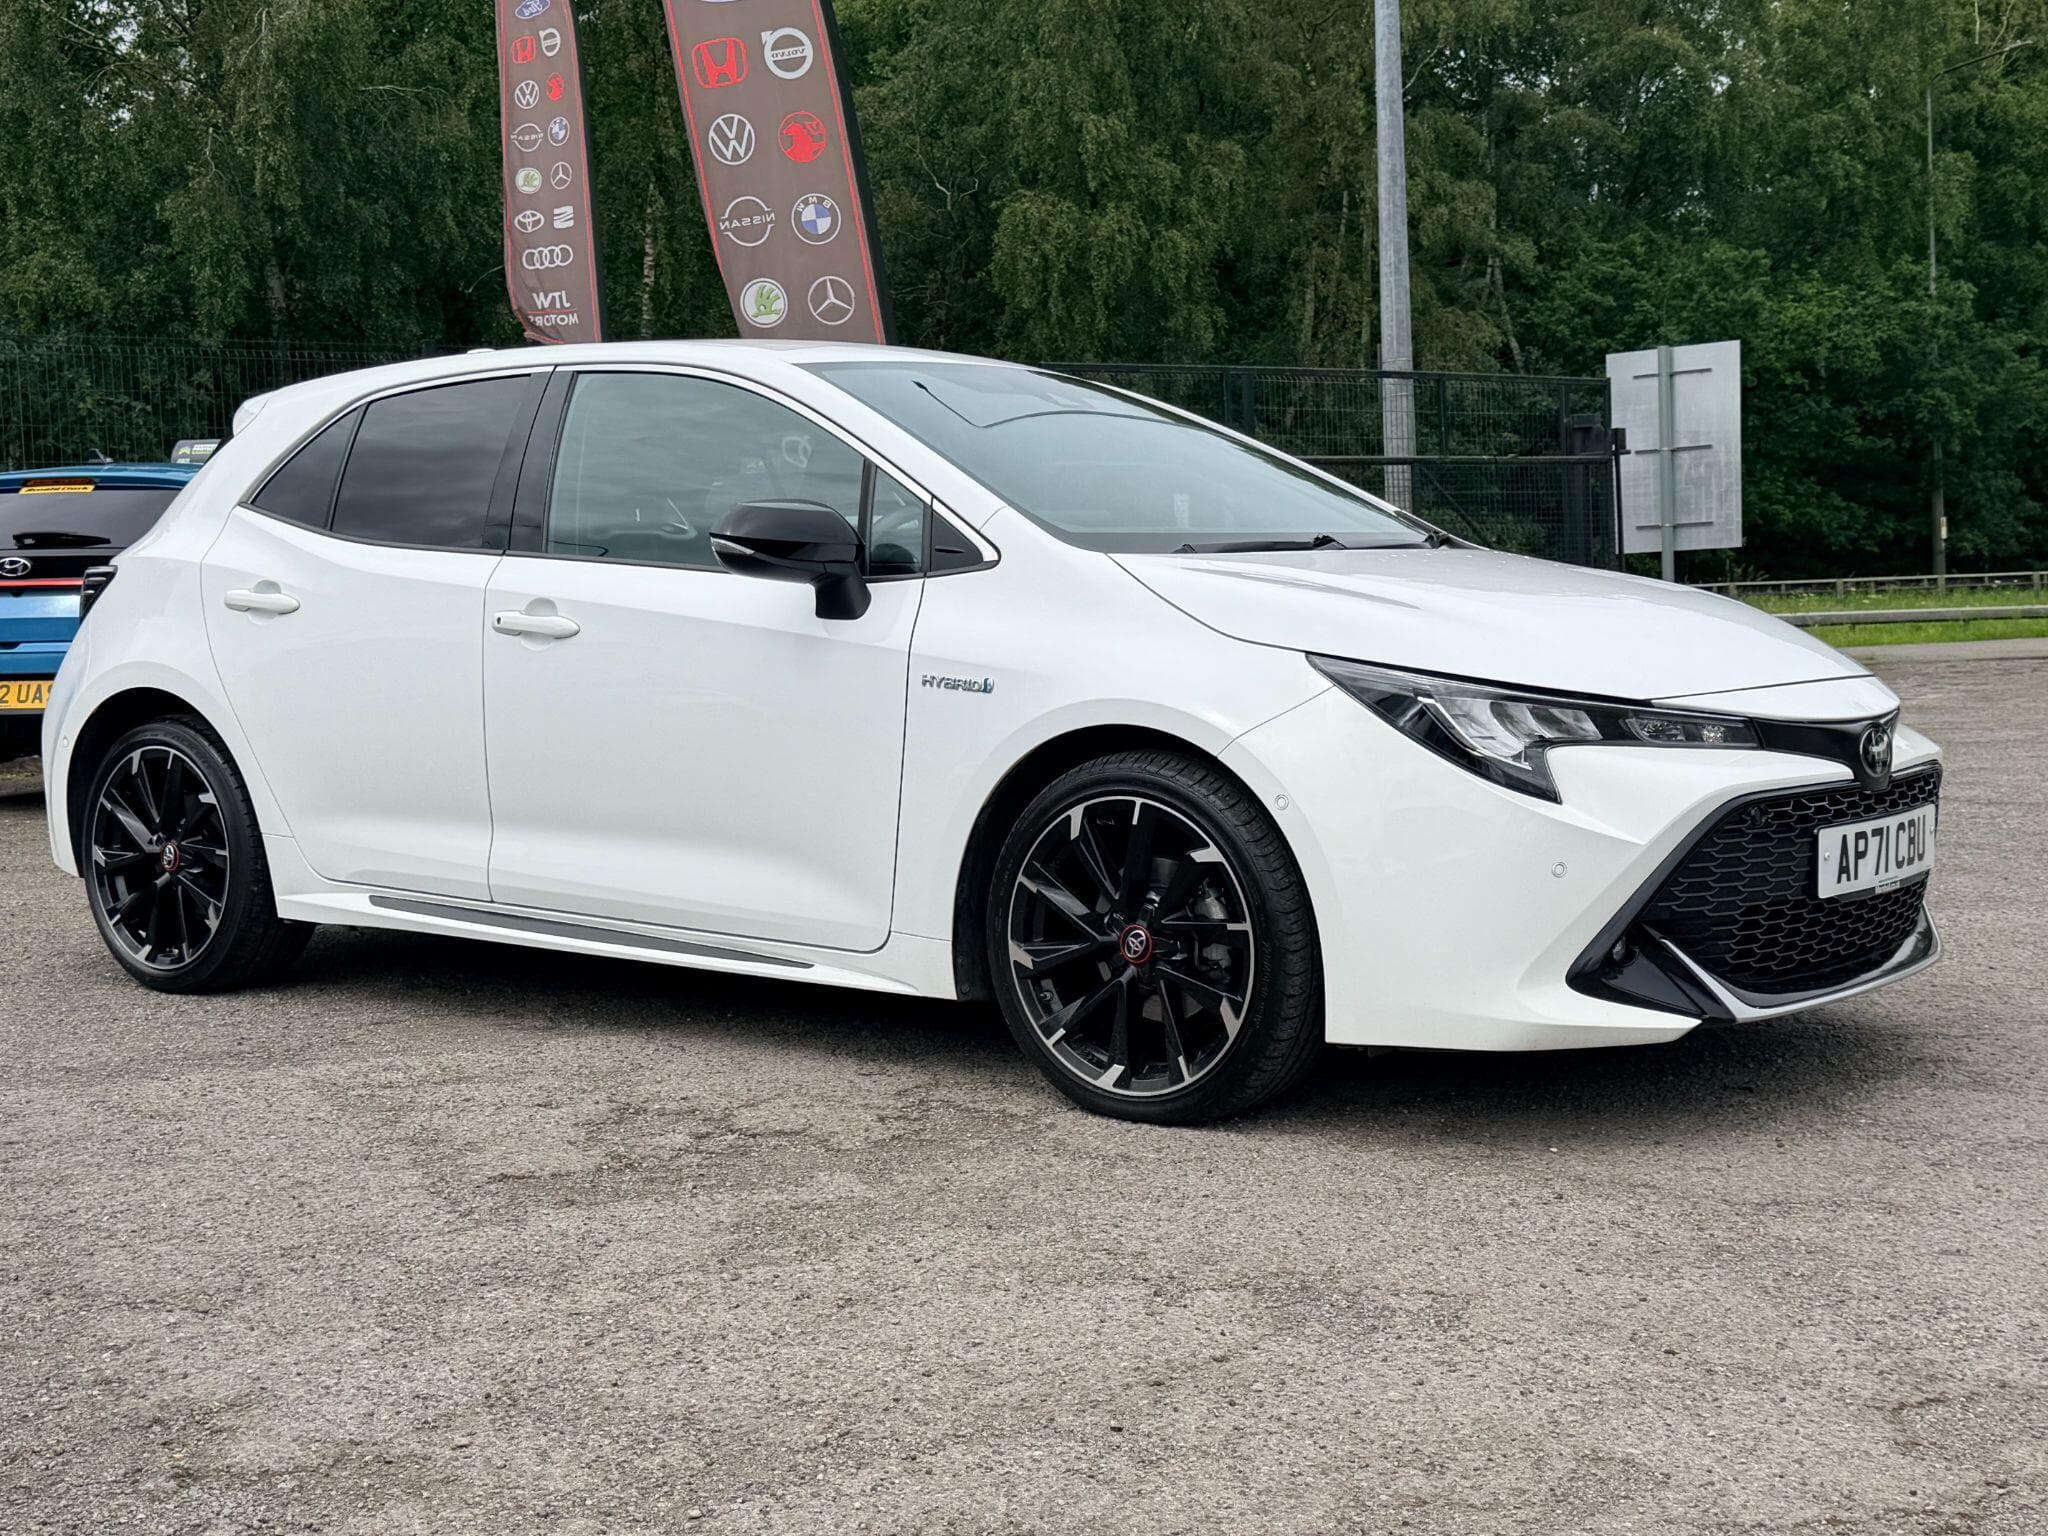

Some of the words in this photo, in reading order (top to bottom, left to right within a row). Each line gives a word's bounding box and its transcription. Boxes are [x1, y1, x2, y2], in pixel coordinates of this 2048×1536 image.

[921, 674, 983, 693] HYBRID
[1836, 825, 1890, 885] AP71
[1895, 814, 1927, 870] CBU
